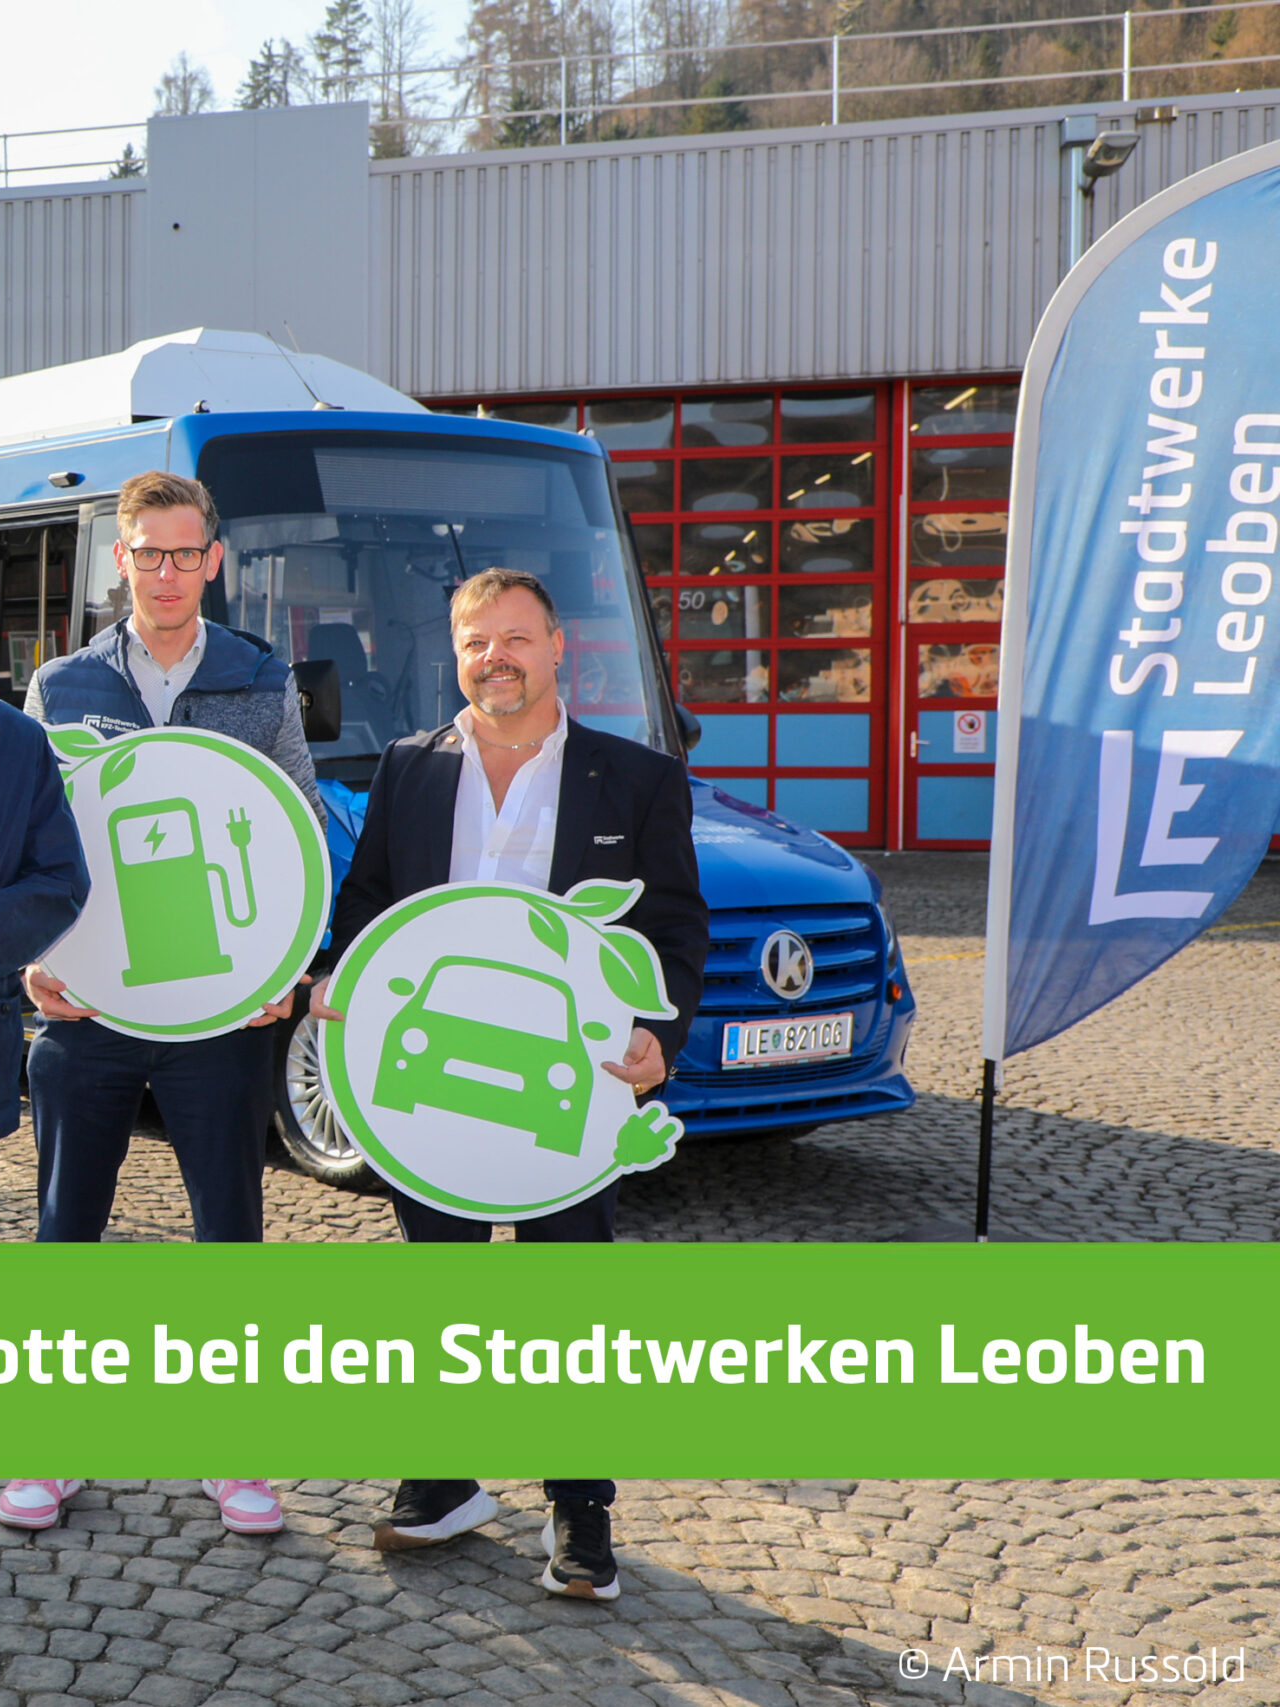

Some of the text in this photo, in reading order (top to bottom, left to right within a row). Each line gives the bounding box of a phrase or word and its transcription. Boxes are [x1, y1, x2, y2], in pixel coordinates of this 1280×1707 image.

[1109, 237, 1218, 697] Stadtwerke
[678, 591, 705, 610] 50
[1192, 412, 1280, 695] Leoben
[744, 1029, 769, 1056] LE
